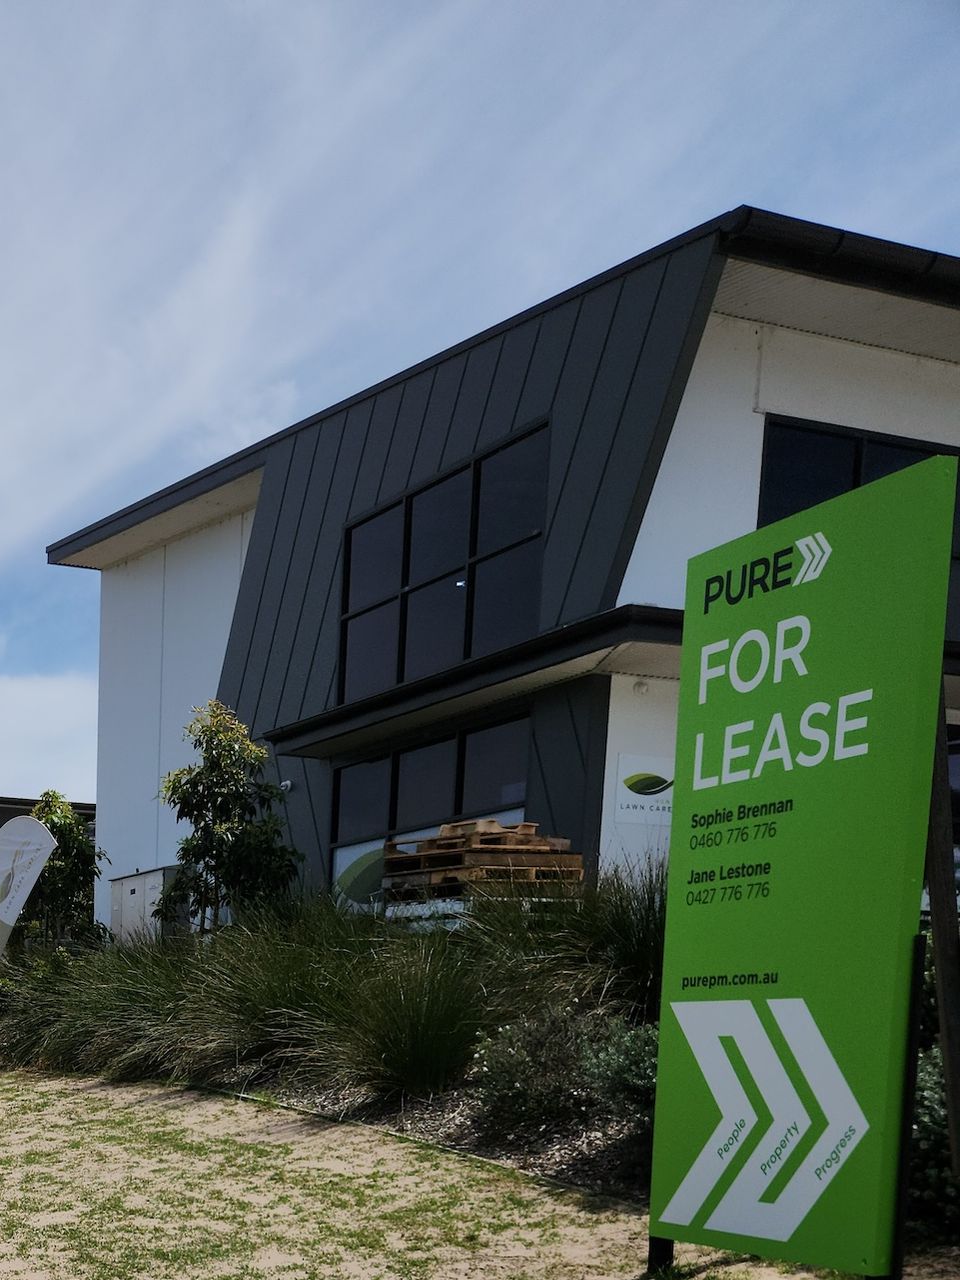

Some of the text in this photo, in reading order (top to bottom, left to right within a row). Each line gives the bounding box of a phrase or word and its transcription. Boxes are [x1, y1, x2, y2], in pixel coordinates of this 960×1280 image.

[703, 546, 793, 615] PURE
[698, 614, 811, 705] FOR
[692, 688, 873, 791] LEASE
[689, 821, 777, 850] 0460 776 776
[691, 799, 793, 829] Sophie Brennan
[686, 881, 769, 906] 0427 776 776
[687, 862, 771, 884] Jane Lestone
[681, 970, 779, 991] purepm.com.au
[717, 1117, 747, 1160] People
[760, 1121, 800, 1176] Property
[814, 1124, 857, 1182] Progress
